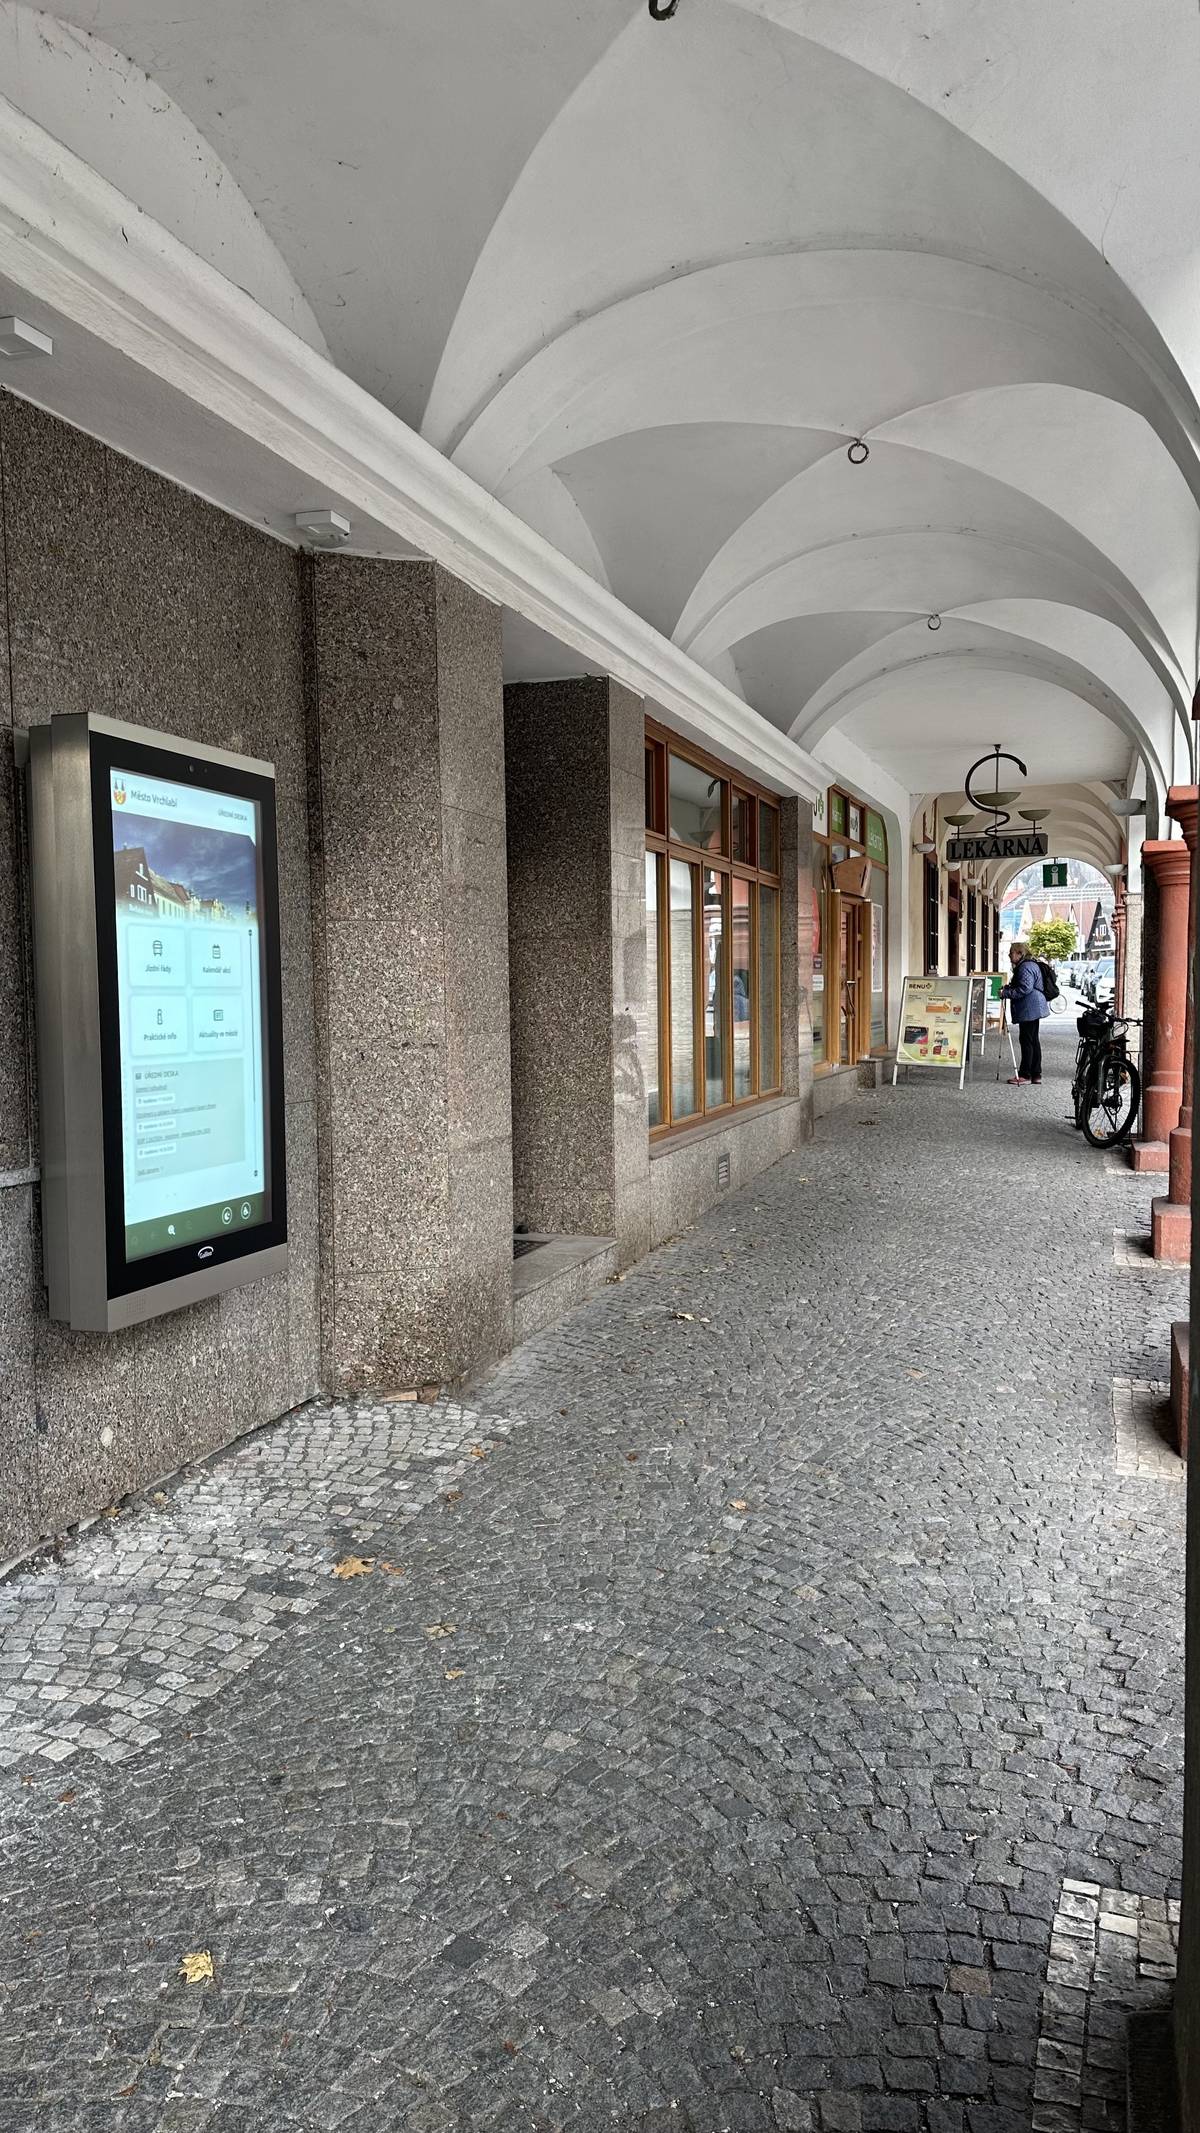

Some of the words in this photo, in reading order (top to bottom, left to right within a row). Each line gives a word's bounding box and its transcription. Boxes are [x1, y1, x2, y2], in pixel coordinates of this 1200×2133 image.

[131, 790, 151, 803] Město
[151, 793, 178, 808] Vrchlabí
[950, 837, 1045, 860] LÉKÁRNA
